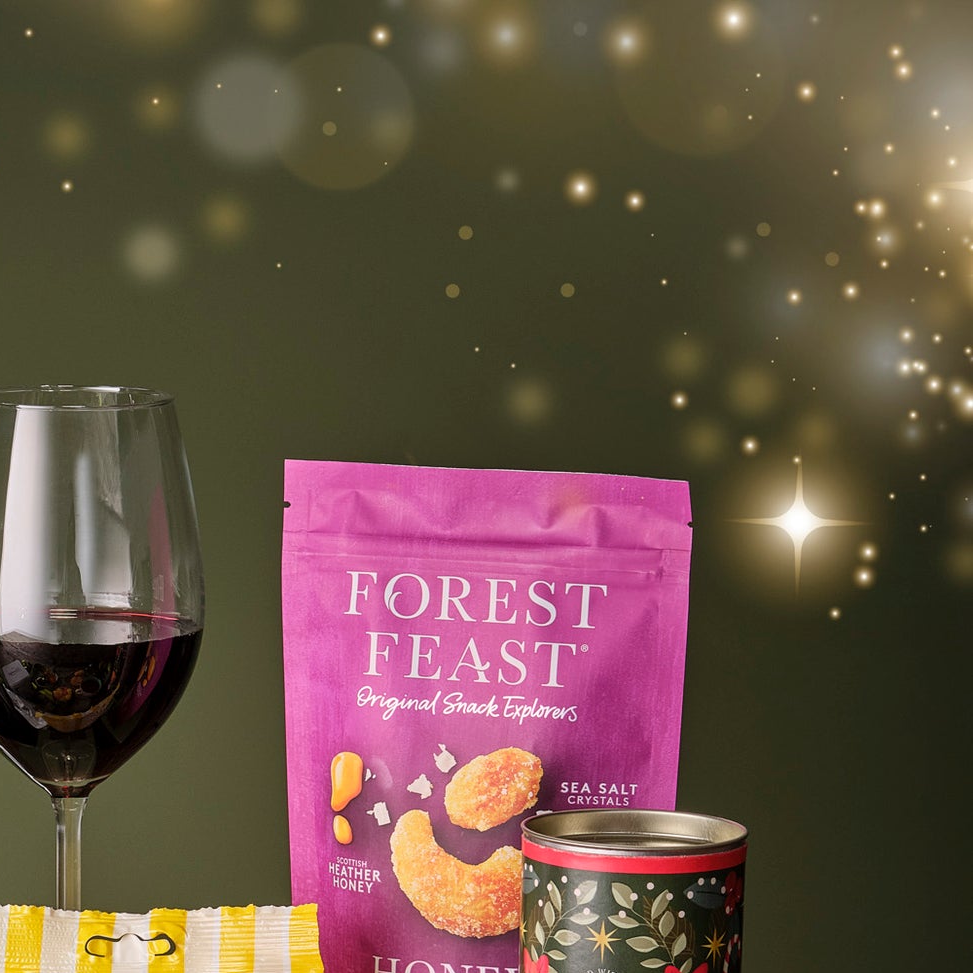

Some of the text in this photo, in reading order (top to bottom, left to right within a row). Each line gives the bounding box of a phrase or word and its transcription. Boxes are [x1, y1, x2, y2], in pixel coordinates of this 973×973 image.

[343, 570, 607, 629] FOREST
[356, 685, 578, 725] Original Snack Explorers
[560, 782, 638, 795] SEA SALT
[567, 795, 629, 806] CRYSTALS
[336, 856, 367, 868] SCOTTISH
[328, 862, 381, 883] HEATHER
[333, 875, 374, 894] HONEY
